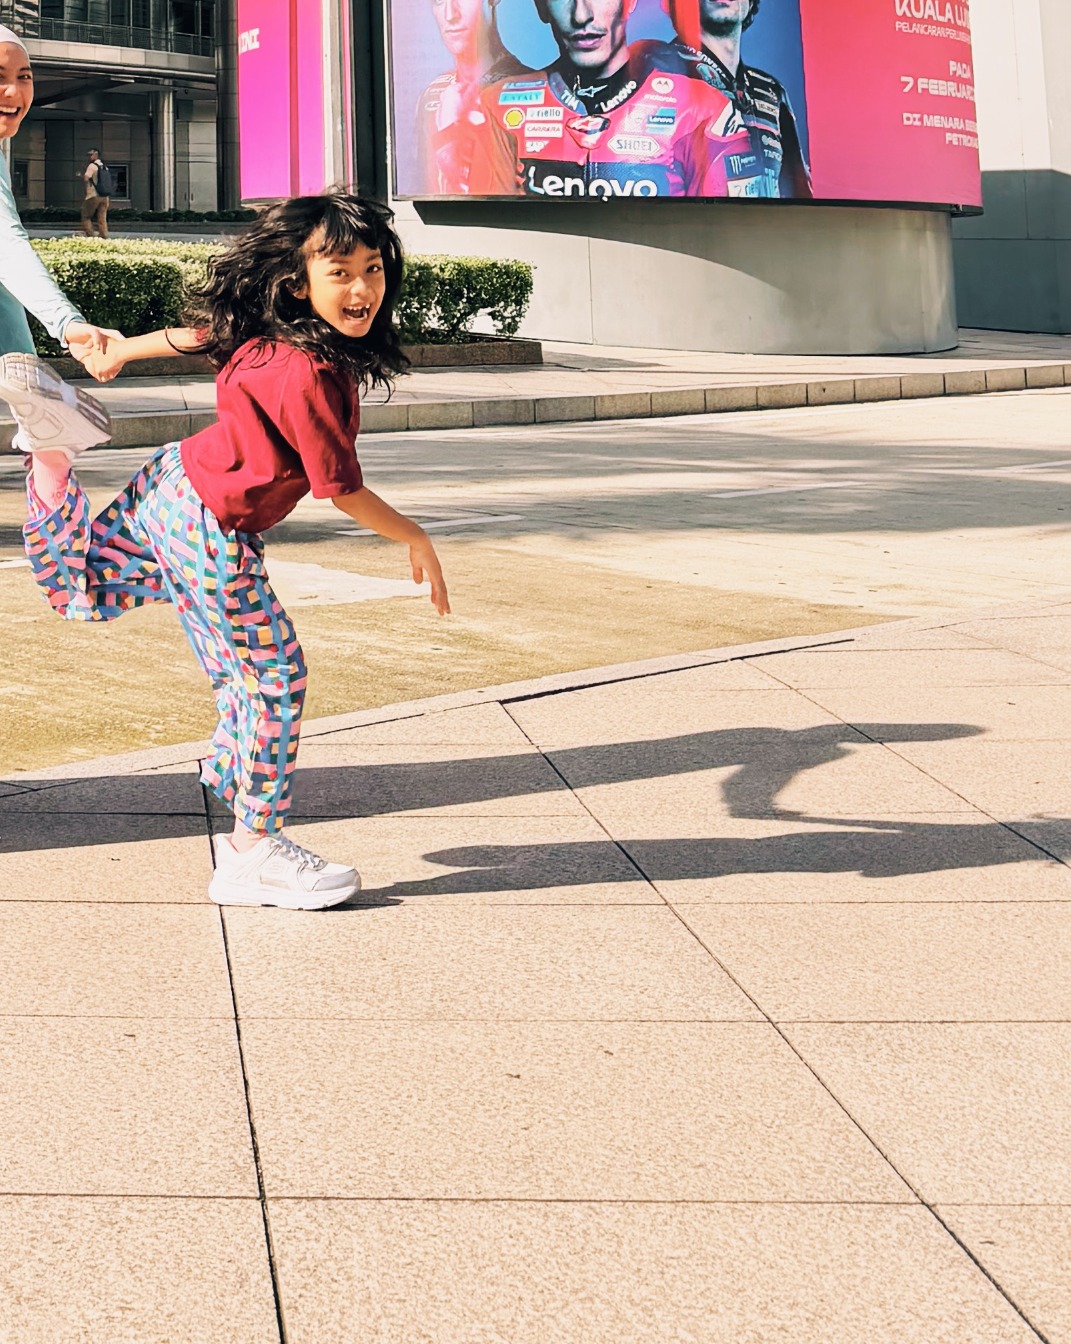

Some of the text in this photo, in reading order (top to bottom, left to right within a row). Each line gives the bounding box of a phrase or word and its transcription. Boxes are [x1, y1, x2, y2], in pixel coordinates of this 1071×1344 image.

[949, 59, 972, 80] PADA
[600, 80, 637, 113] Lenovo
[900, 75, 975, 102] 7 FEBRUAR
[902, 112, 922, 126] DI
[923, 114, 965, 131] MENARA
[616, 139, 653, 152] SHOEI
[528, 165, 658, 199] Lenovo
